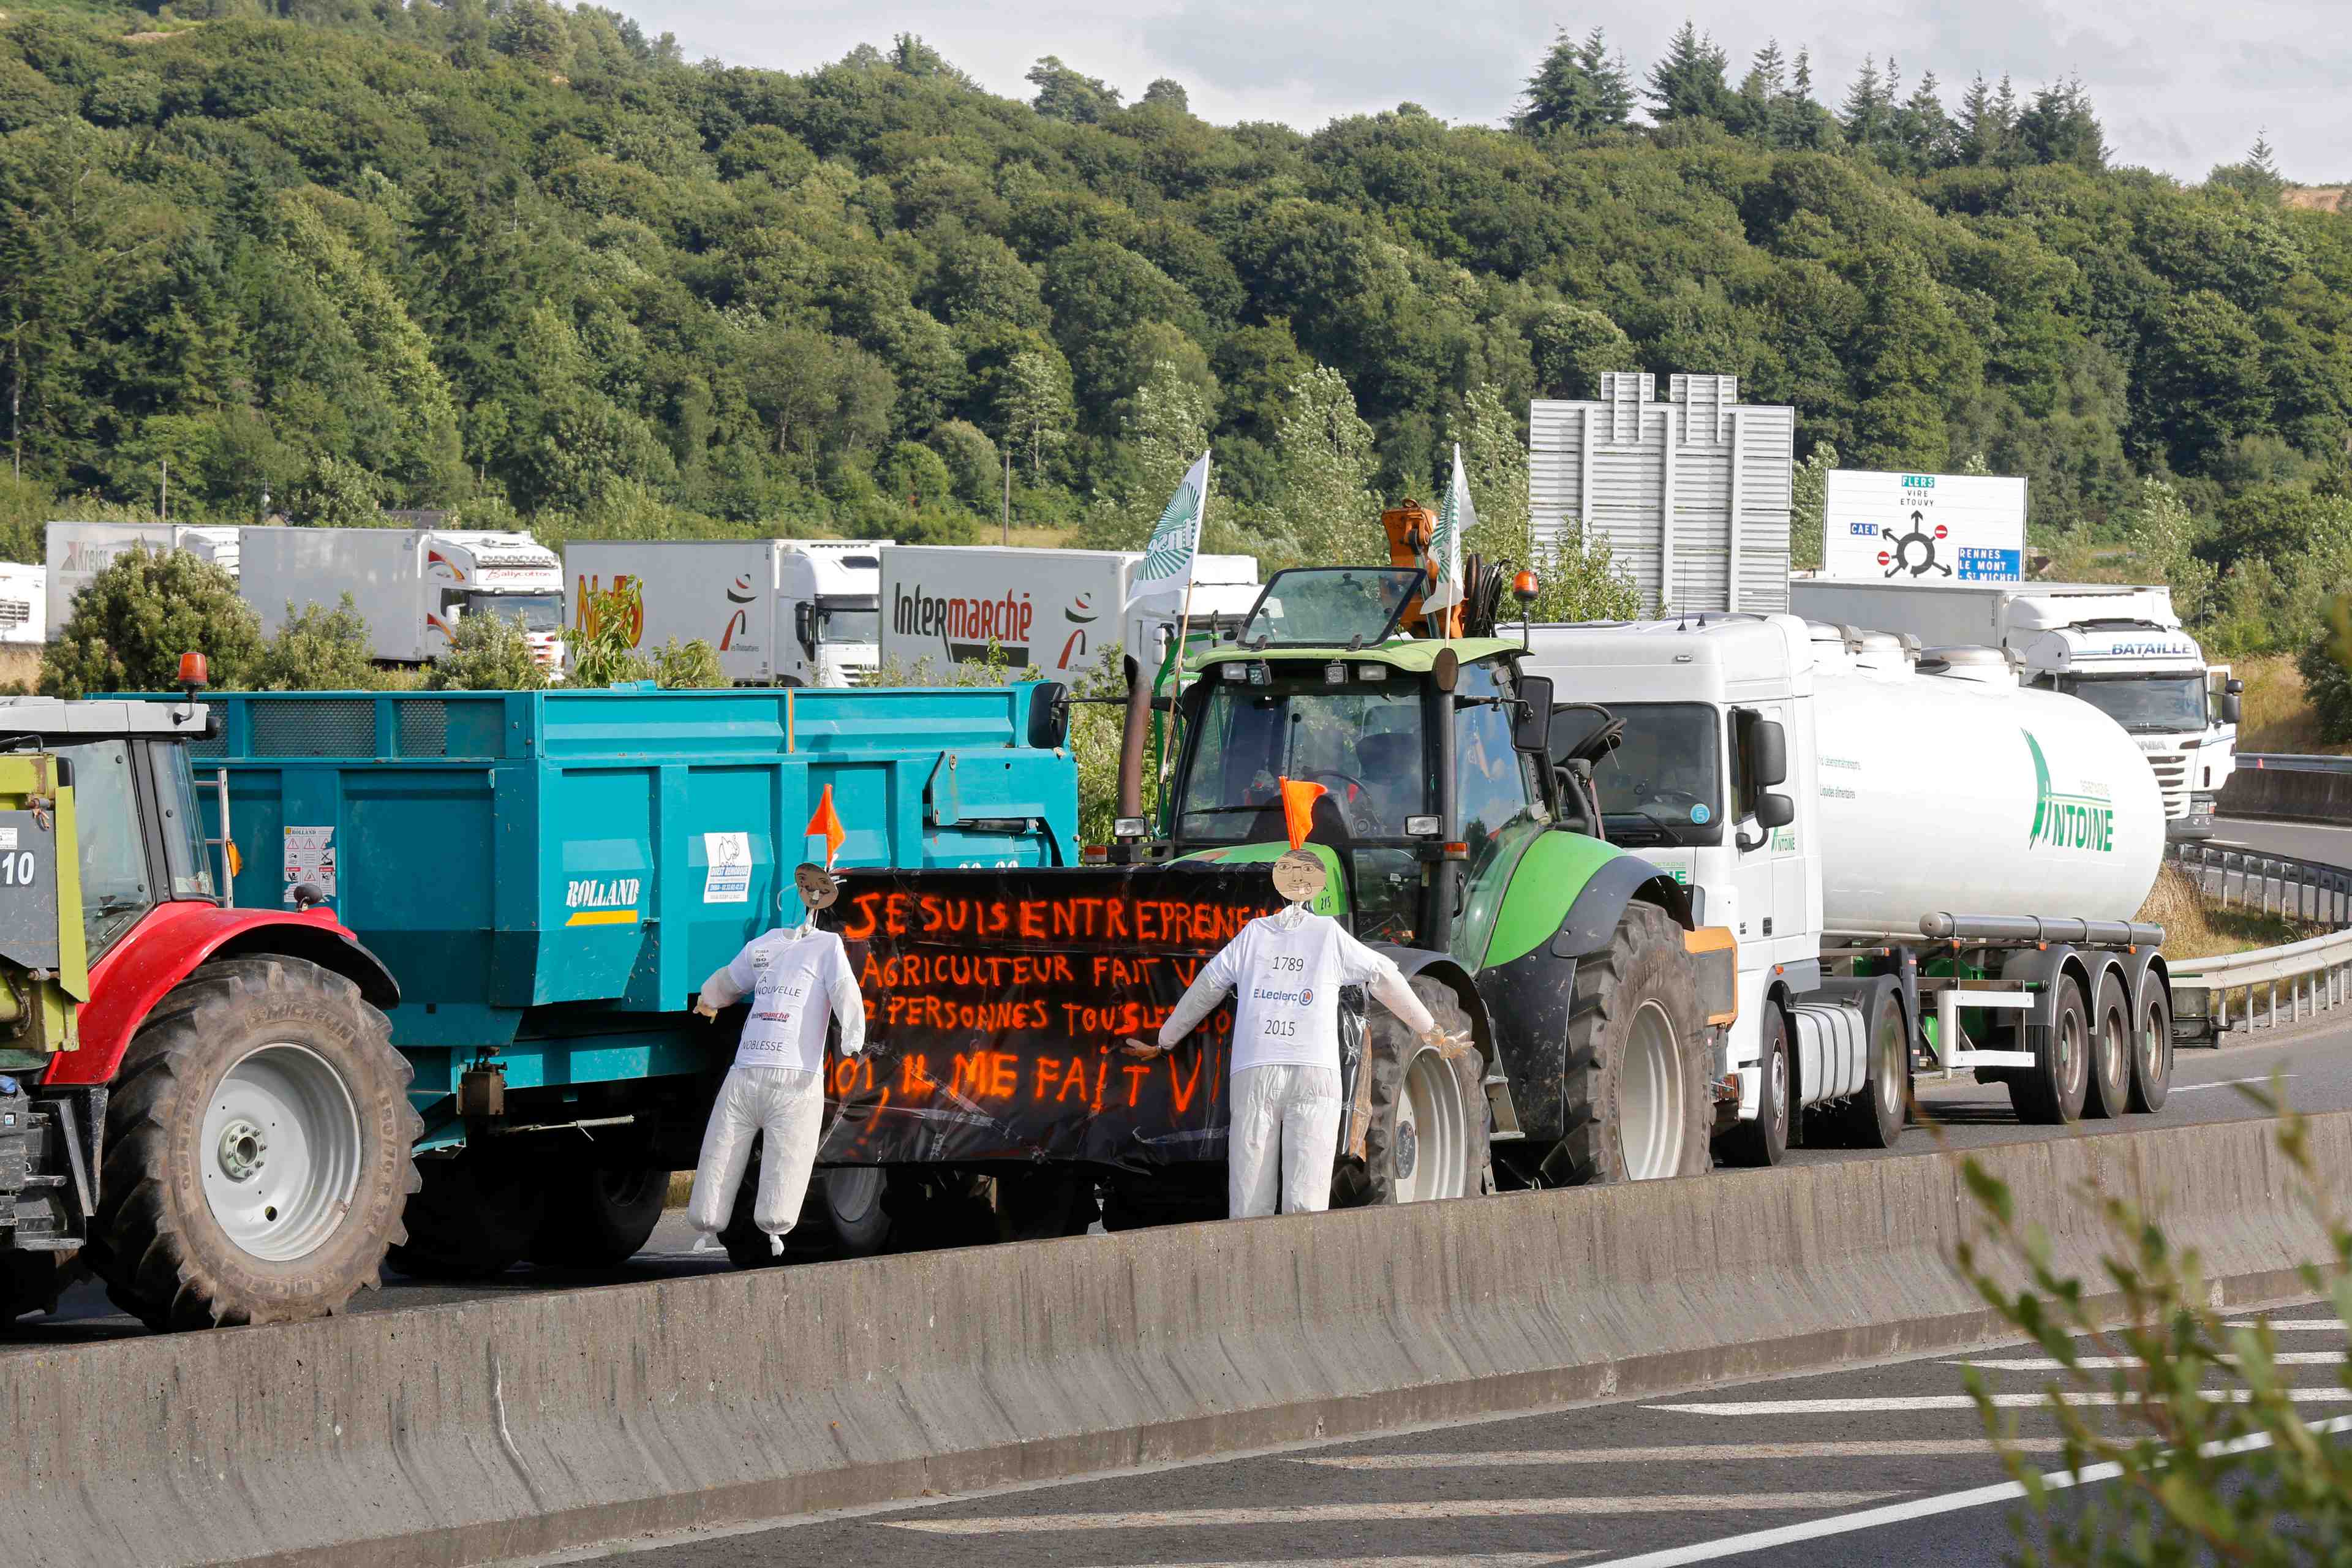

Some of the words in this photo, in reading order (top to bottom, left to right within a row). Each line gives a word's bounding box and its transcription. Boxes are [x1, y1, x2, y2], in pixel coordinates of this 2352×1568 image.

[1902, 476, 1934, 487] FLERS
[1900, 498, 1934, 507] ETOUVY
[1851, 524, 1878, 535] CAEN
[1960, 549, 2000, 560] RENNES
[1959, 560, 1970, 570] LE
[1977, 560, 2007, 571] MONT
[485, 568, 551, 580] Ballycotton
[894, 582, 1033, 663] Intermarché
[2111, 643, 2192, 655] BATAILLE
[566, 879, 640, 908] ROLLAND
[845, 892, 908, 939] JE
[919, 896, 1009, 935] SUIS
[1272, 956, 1304, 972] 1789
[1094, 956, 1160, 987] FAIT
[756, 985, 802, 998] NOUVELLE
[1253, 989, 1298, 1001] E.Leclerc
[888, 995, 1049, 1031] PERSONNES
[1061, 1001, 1139, 1036] TOUS
[1265, 1019, 1295, 1036] 2015
[743, 1040, 783, 1052] NOBLESSE
[952, 1050, 1017, 1099] ME
